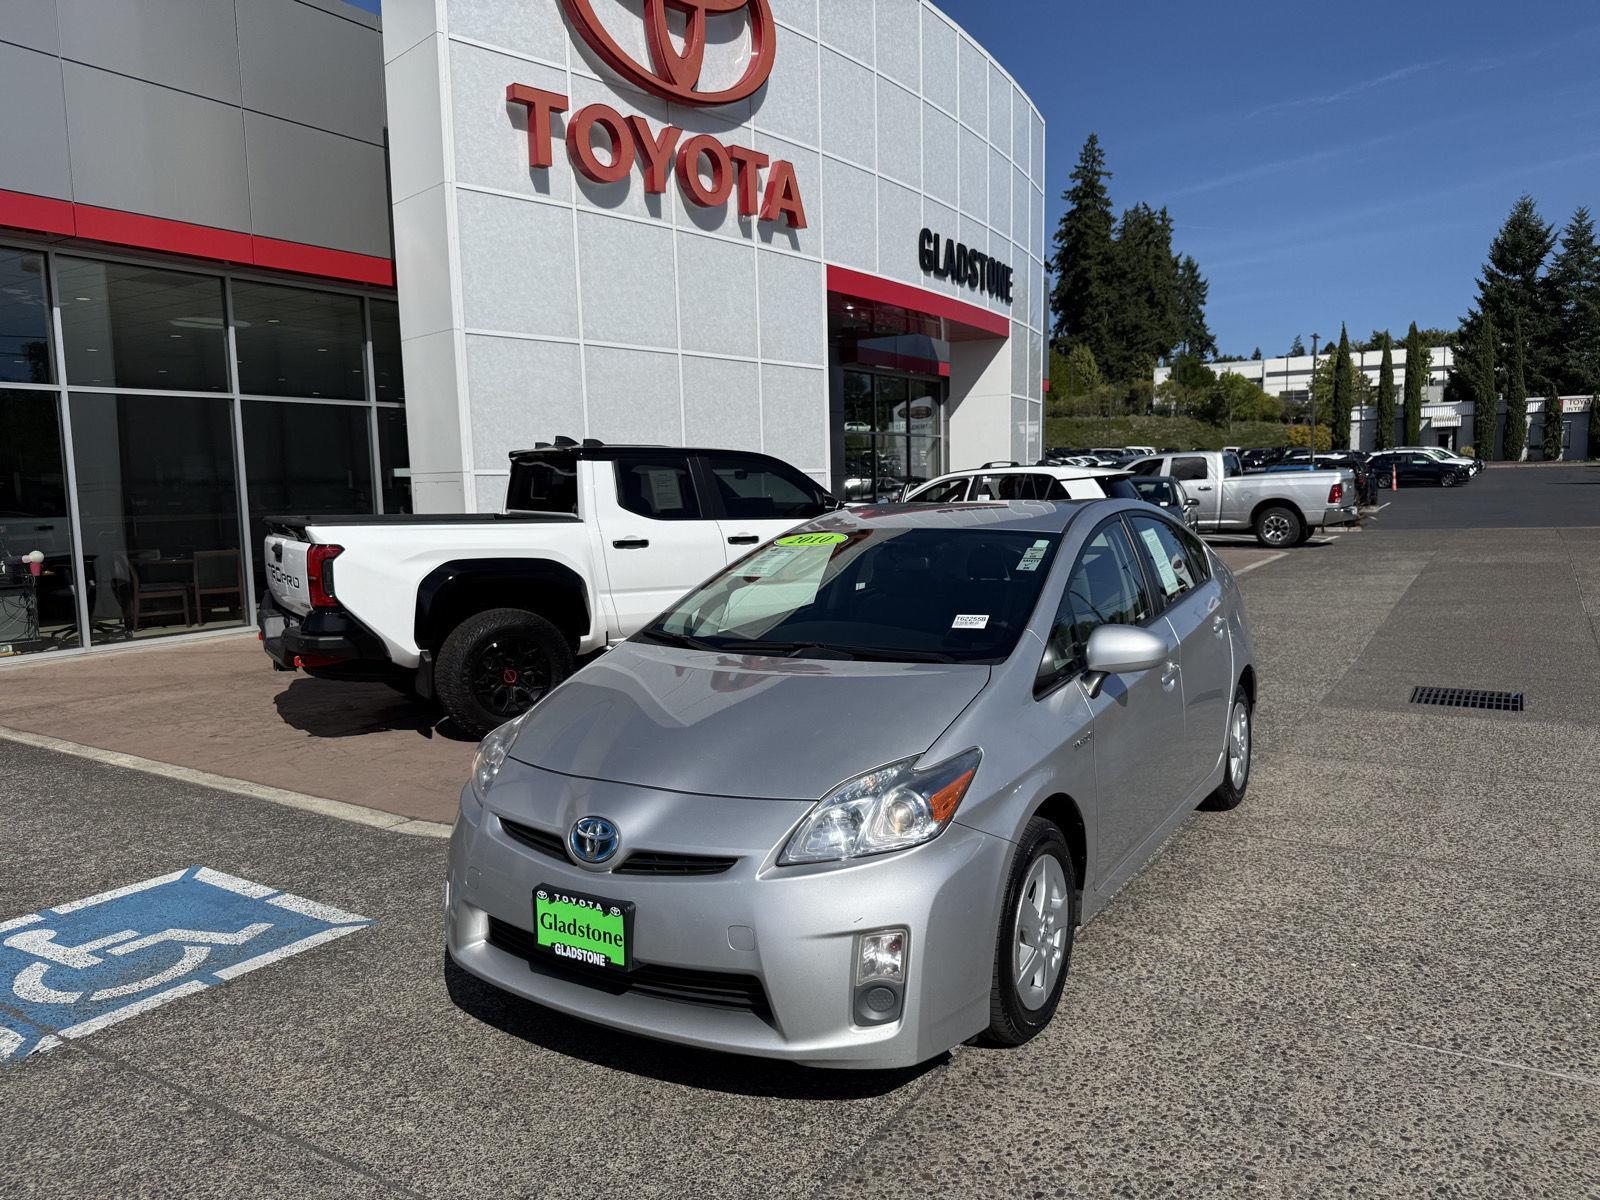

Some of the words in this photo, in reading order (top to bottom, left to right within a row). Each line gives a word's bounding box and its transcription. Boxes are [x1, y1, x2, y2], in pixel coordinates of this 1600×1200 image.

[506, 83, 807, 229] TOYOTA
[918, 228, 1013, 303] GLADSTONE
[787, 535, 834, 544] 2010
[554, 893, 603, 911] TOYOTA
[540, 912, 623, 947] Gladstone
[554, 943, 606, 966] GLADSTONE
